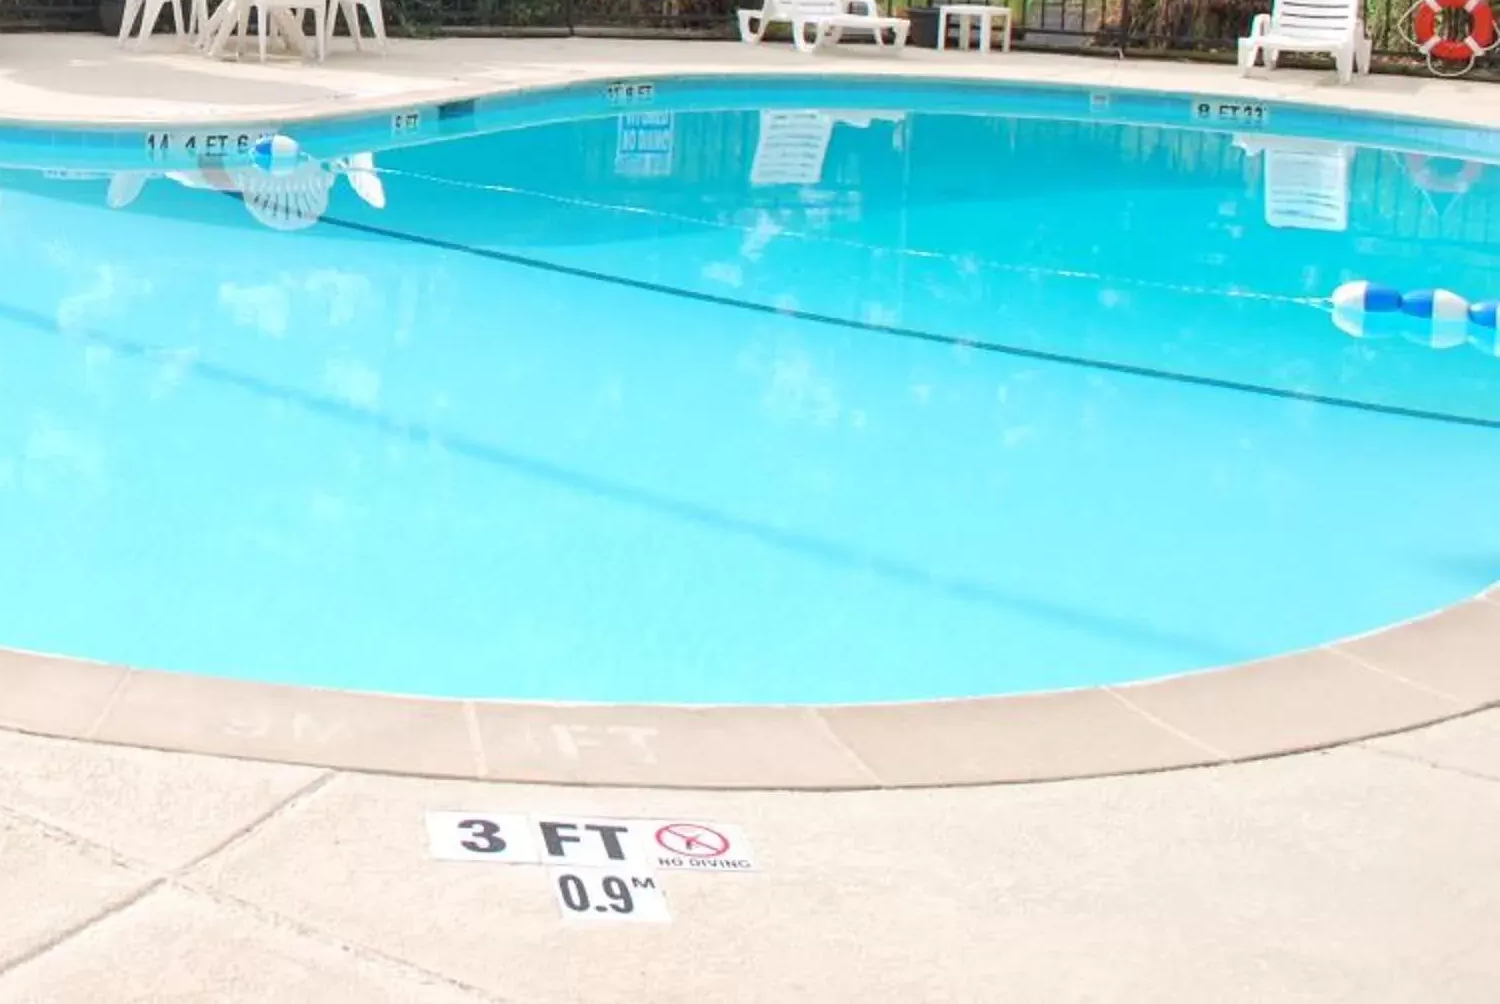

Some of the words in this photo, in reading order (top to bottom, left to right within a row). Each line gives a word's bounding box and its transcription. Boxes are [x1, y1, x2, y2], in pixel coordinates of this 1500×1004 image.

[457, 818, 507, 853] 3
[538, 821, 629, 861] FT
[658, 857, 683, 867] NO
[688, 858, 751, 869] DIVING
